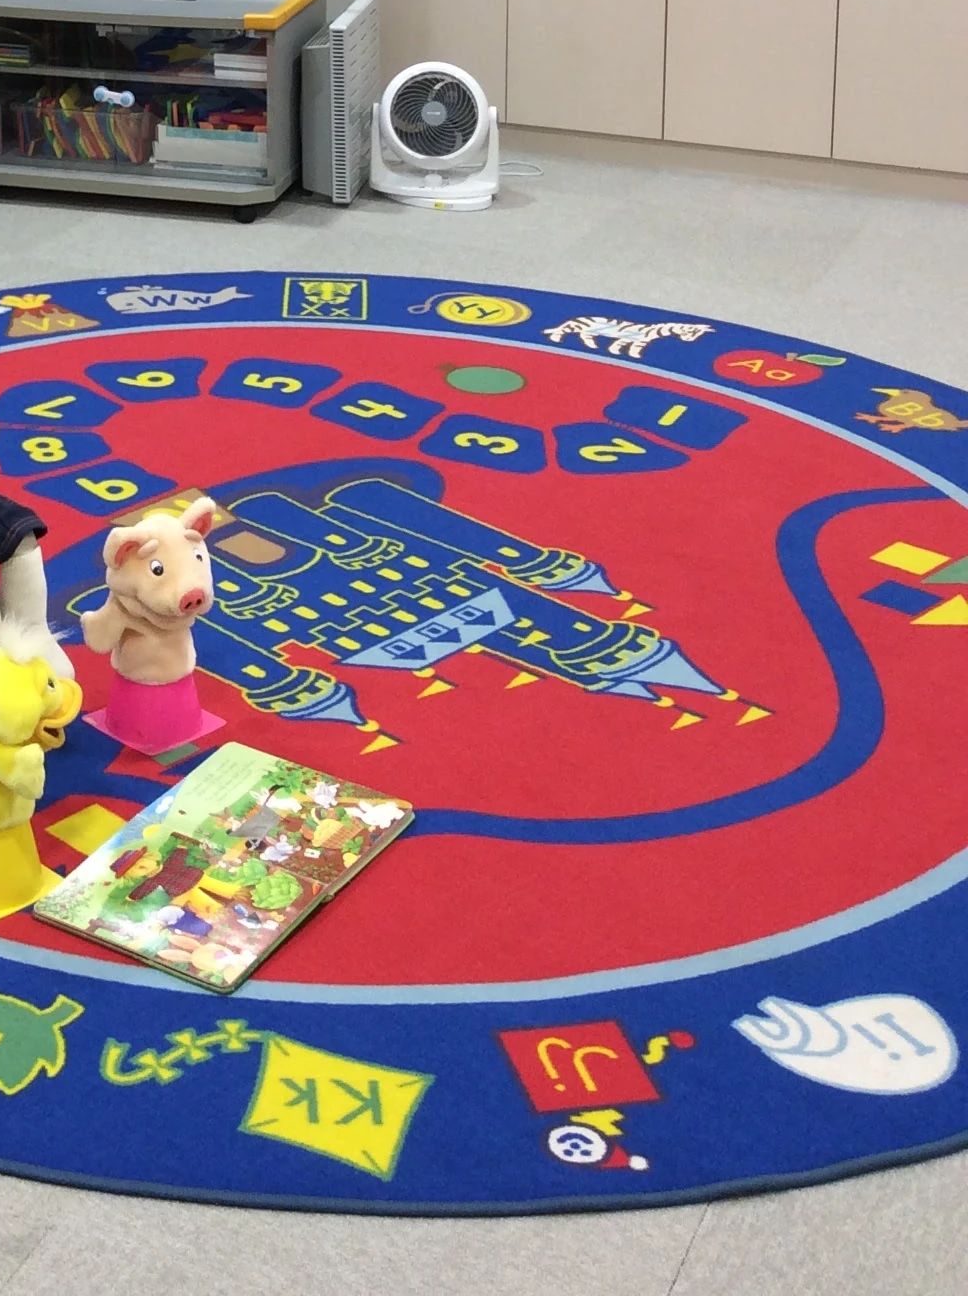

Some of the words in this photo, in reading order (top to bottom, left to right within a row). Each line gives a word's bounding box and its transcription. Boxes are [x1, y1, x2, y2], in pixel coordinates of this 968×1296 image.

[117, 371, 175, 388] 6
[243, 373, 302, 393] 5
[24, 395, 77, 419] 7
[341, 399, 407, 419] 4
[21, 436, 68, 462] 8
[454, 431, 519, 455] 3
[579, 437, 647, 463] 2
[74, 477, 138, 501] 9
